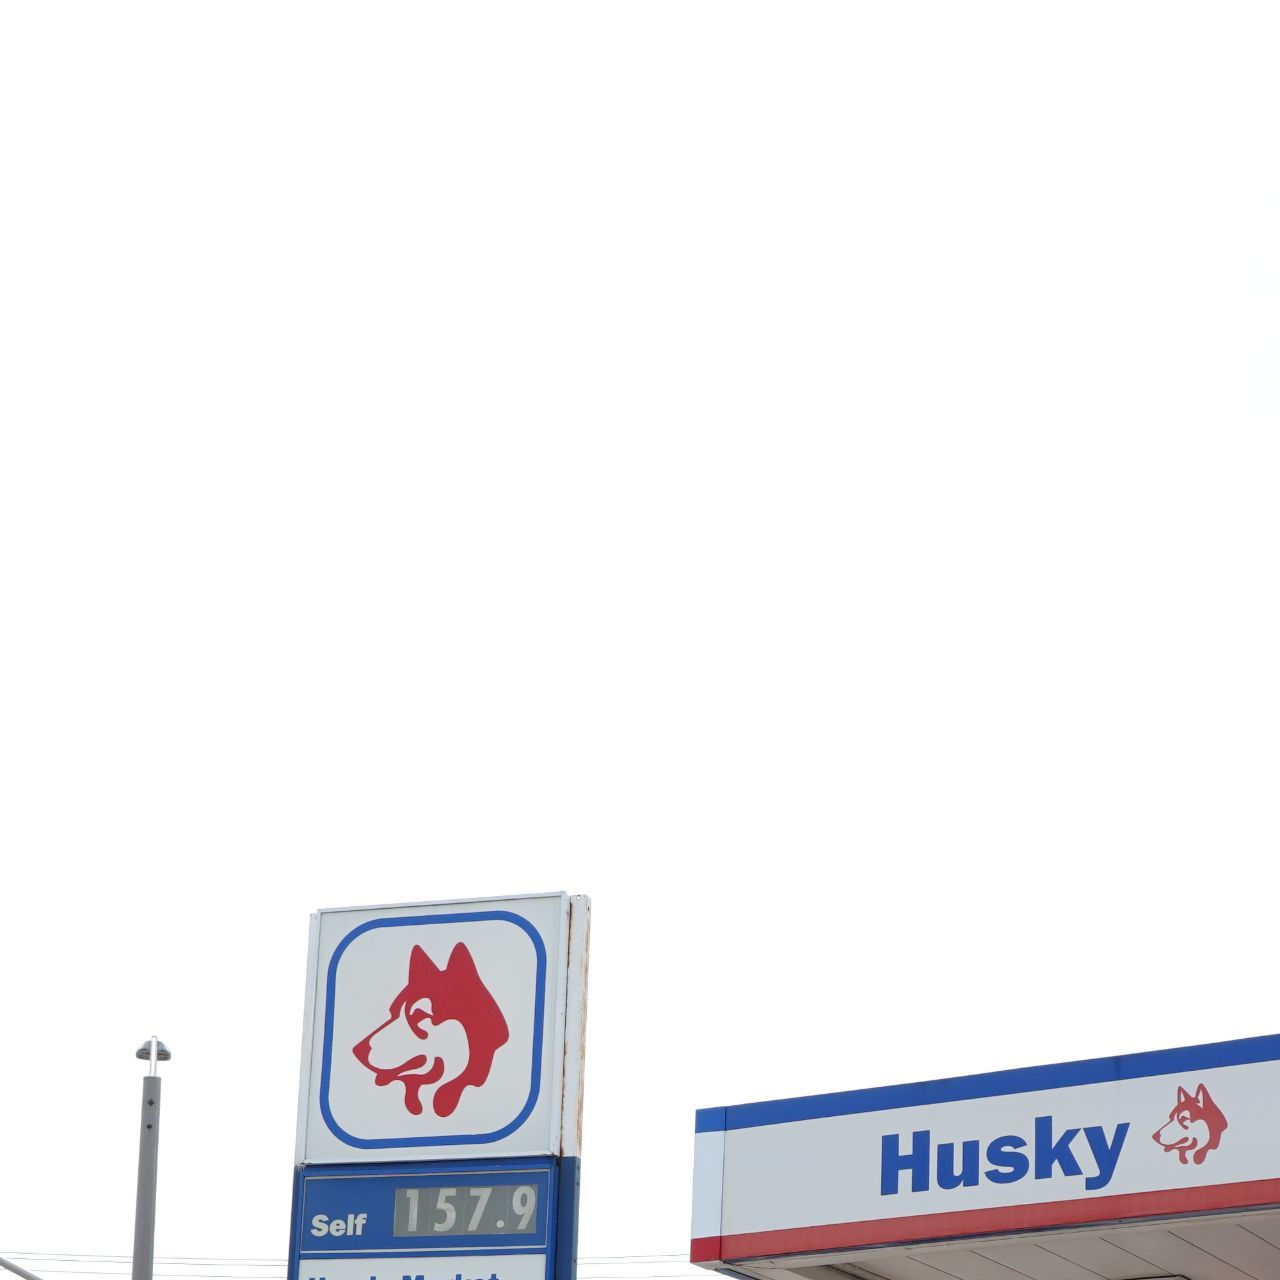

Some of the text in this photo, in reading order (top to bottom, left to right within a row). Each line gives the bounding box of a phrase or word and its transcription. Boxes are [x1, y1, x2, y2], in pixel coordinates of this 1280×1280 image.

[880, 1116, 1130, 1196] Husky
[310, 1185, 536, 1237] Self 157.9
